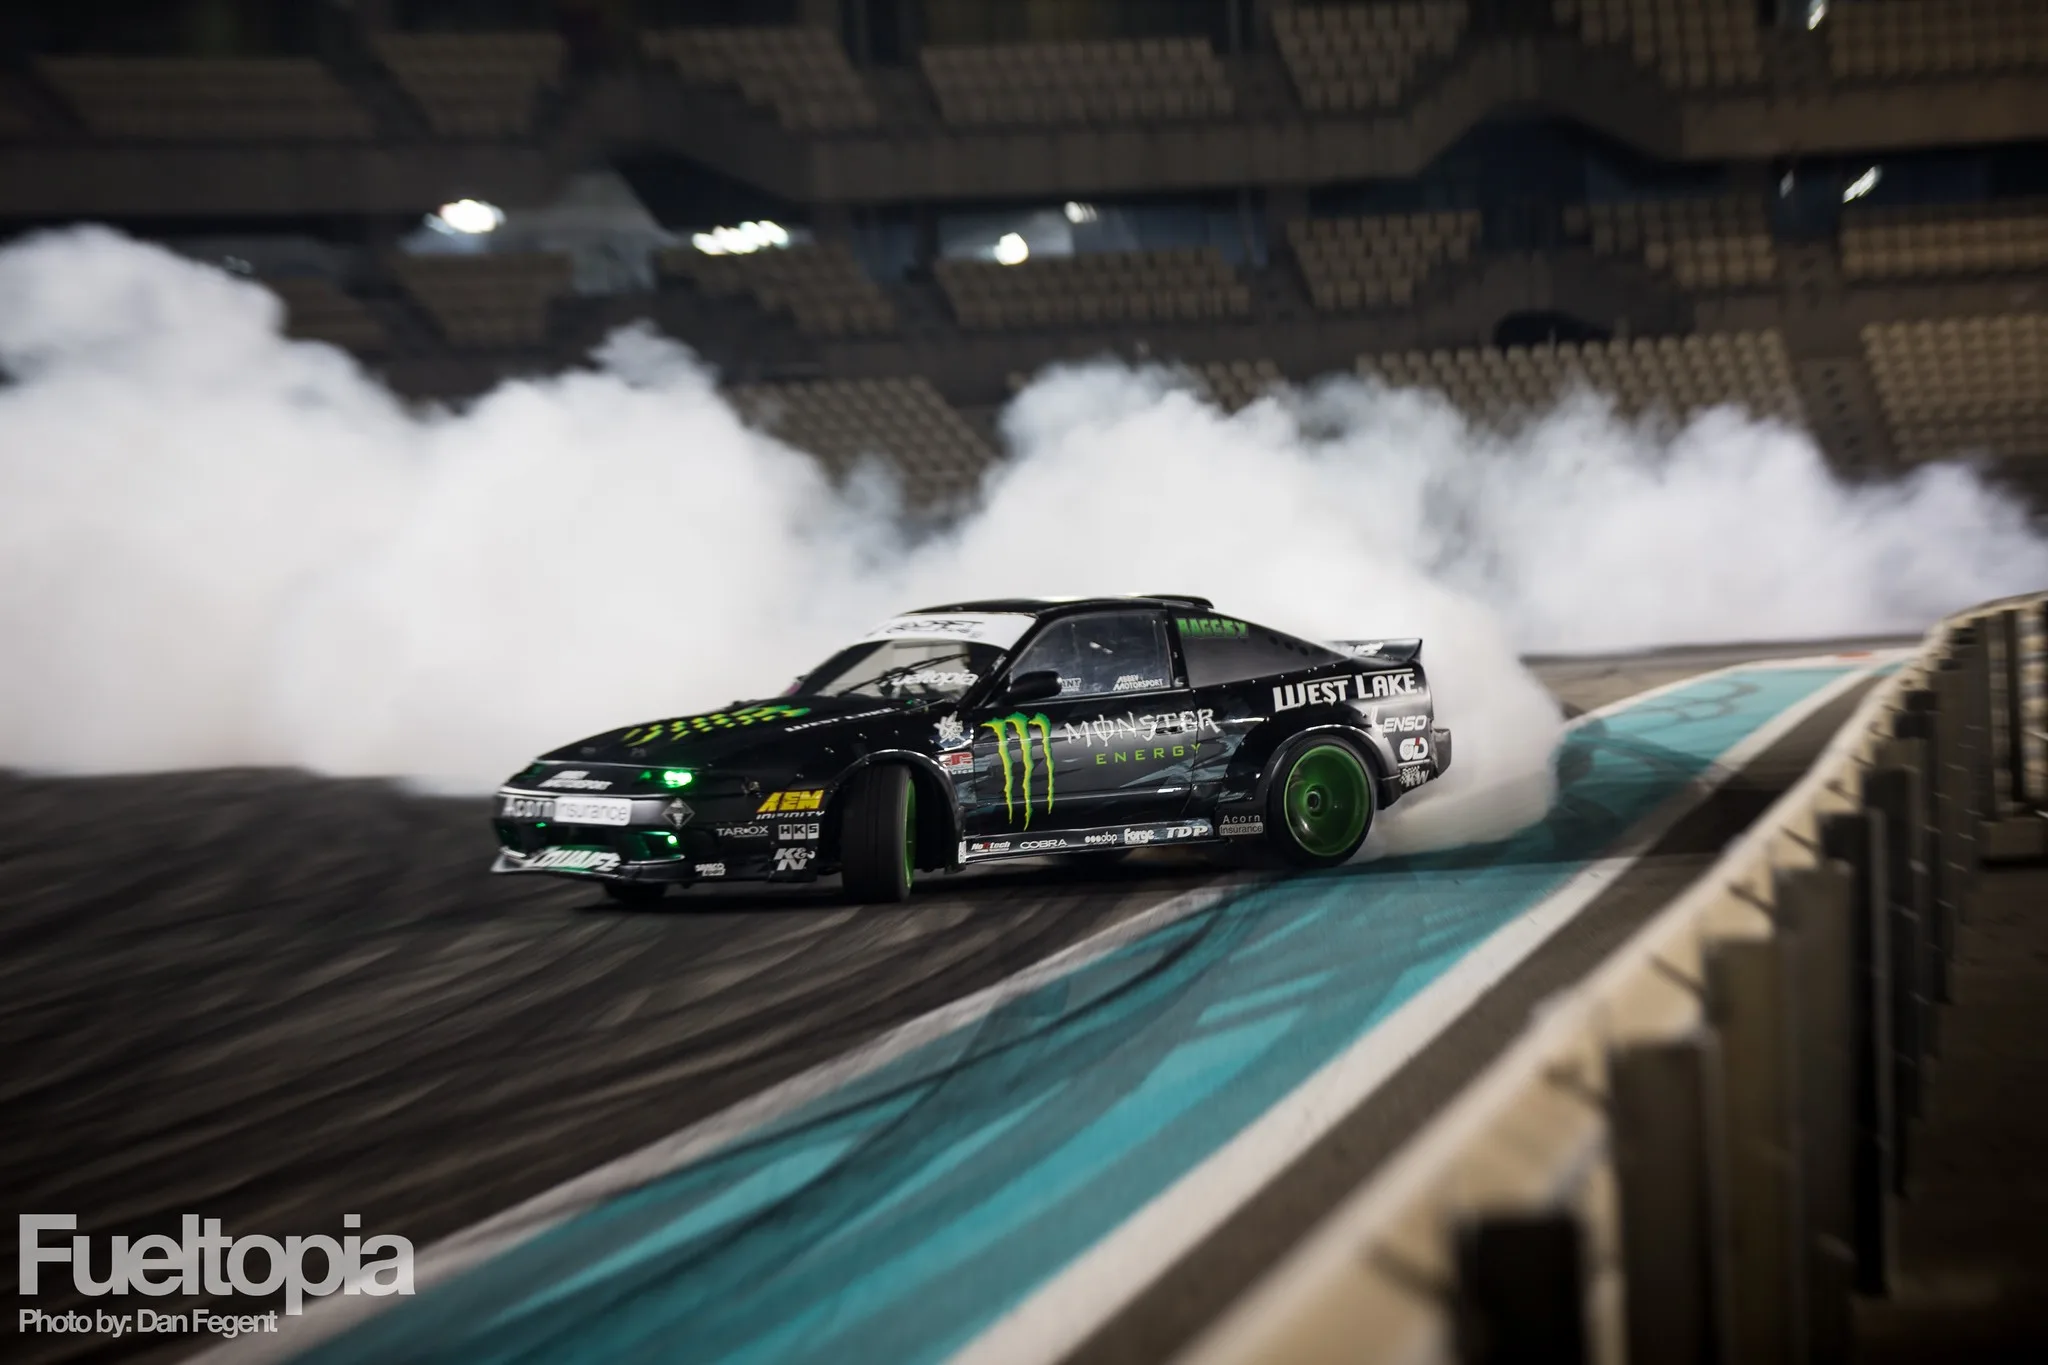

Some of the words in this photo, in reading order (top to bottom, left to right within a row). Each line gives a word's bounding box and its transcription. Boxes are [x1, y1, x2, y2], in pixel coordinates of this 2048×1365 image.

[1112, 679, 1164, 692] MOTORSPORT
[1272, 679, 1350, 713] WEST
[1355, 673, 1417, 699] LAKE
[1064, 708, 1221, 748] MONSTER
[1096, 743, 1201, 765] ENERGY
[757, 790, 824, 812] AEM
[1222, 814, 1261, 825] Acorn
[778, 823, 820, 840] HKS
[1220, 824, 1262, 836] Insurance
[1020, 839, 1068, 849] COBRA
